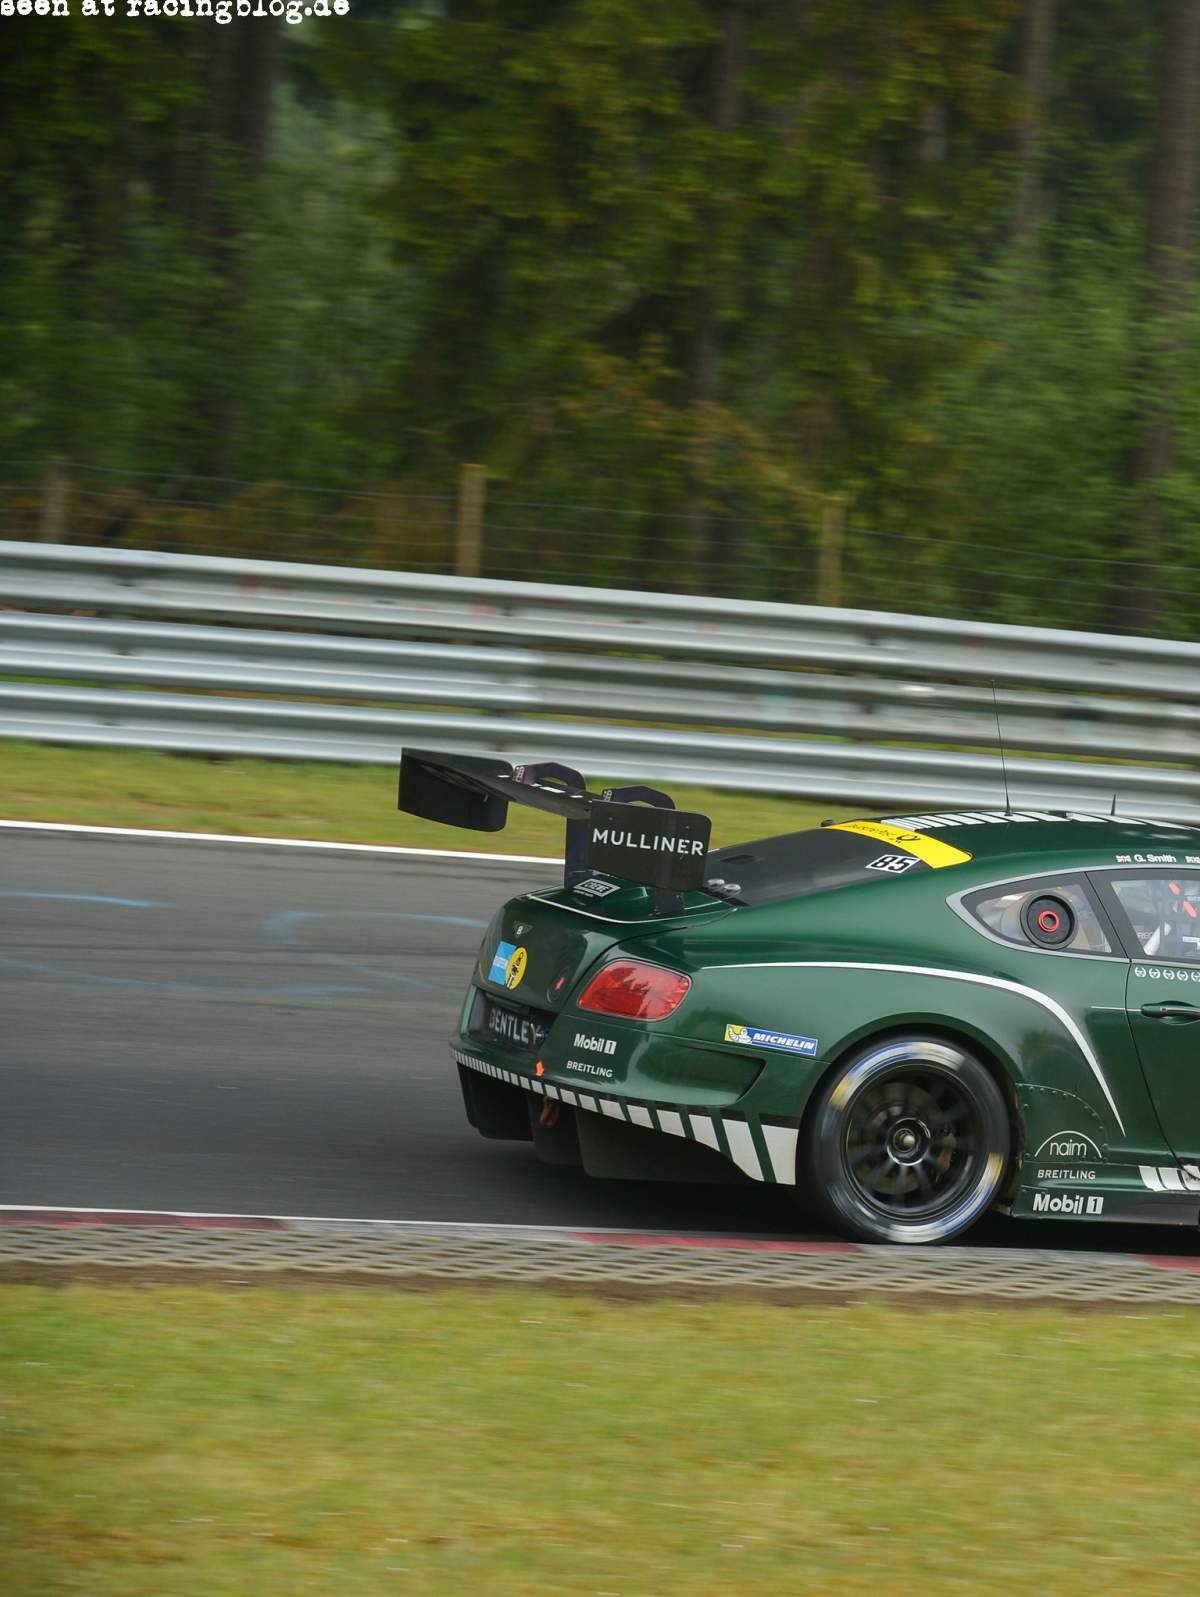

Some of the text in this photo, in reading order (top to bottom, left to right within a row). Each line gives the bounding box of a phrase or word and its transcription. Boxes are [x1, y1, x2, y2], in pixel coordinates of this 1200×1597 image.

[592, 828, 704, 856] MULLINER
[870, 855, 913, 871] 85
[1134, 854, 1177, 864] G. Smith
[488, 1007, 541, 1045] BENTLEY
[573, 1033, 604, 1053] Mobil
[752, 1032, 815, 1050] MICHELIN
[566, 1060, 613, 1078] BREITLING
[1050, 1139, 1087, 1157] naim
[1037, 1169, 1096, 1180] BREITLING
[1033, 1193, 1104, 1215] Mobil 1
